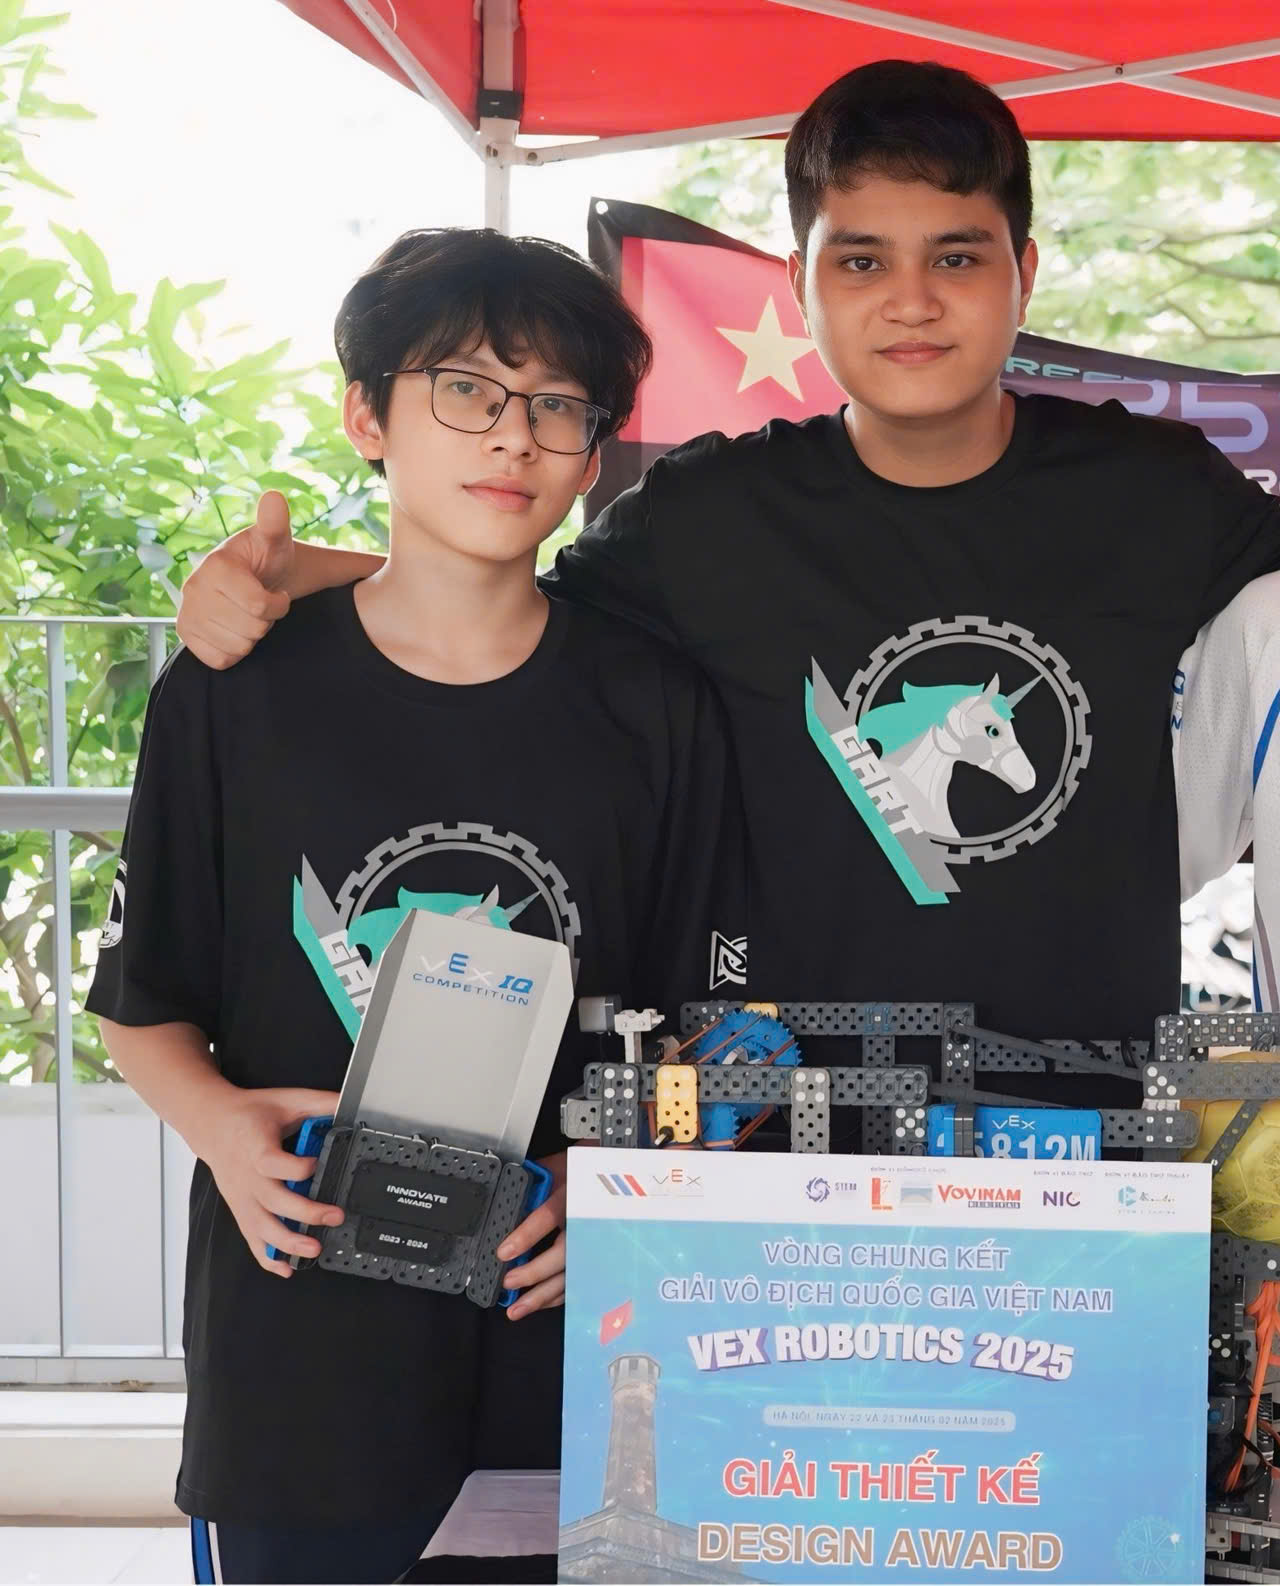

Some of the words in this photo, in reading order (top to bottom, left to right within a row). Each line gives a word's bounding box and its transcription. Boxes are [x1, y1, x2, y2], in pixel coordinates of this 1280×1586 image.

[412, 972, 529, 1006] COMPETITION
[420, 952, 494, 987] VEX
[498, 975, 534, 995] IQ
[992, 1115, 1036, 1130] VEX
[652, 1168, 701, 1186] VEX
[386, 1184, 449, 1205] INNOVATE
[397, 1196, 433, 1210] AWARD
[938, 1184, 1021, 1203] VOVINAM
[1043, 1190, 1081, 1207] NIC
[764, 1237, 842, 1266] VÒNG
[851, 1244, 948, 1269] CHUNG
[956, 1238, 1010, 1271] KẾT
[661, 1273, 715, 1302] GIẢI
[722, 1274, 759, 1303] VÔ
[768, 1281, 834, 1311] ĐỊCH
[842, 1275, 922, 1307] QUỐC
[930, 1284, 977, 1309] GIA
[984, 1281, 1045, 1317] VIỆT
[1051, 1287, 1113, 1313] NAM
[687, 1327, 771, 1371] VEX
[774, 1322, 965, 1364] ROBOTICS
[971, 1331, 1075, 1381] 2025
[722, 1449, 818, 1499] GIẢI
[830, 1449, 966, 1503] THIẾT
[977, 1452, 1043, 1506] KẾ
[697, 1522, 874, 1567] DESIGN
[885, 1528, 1063, 1572] AWARD
